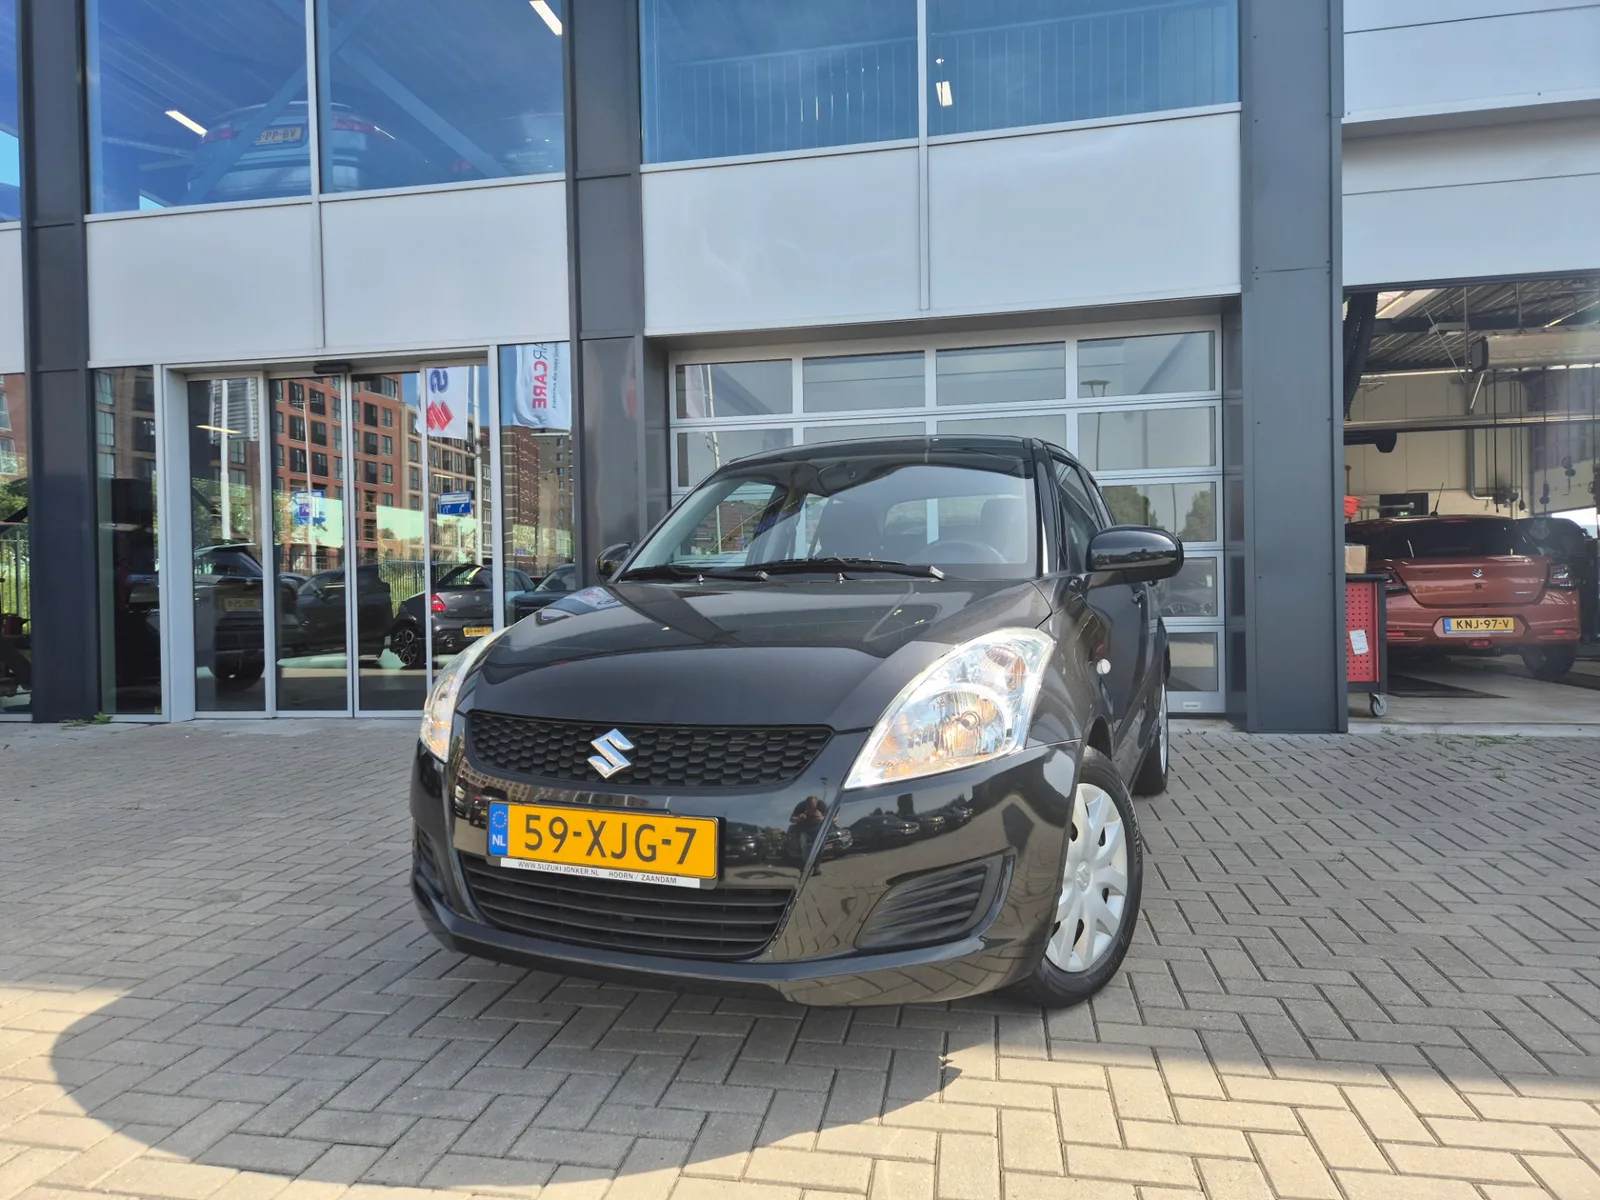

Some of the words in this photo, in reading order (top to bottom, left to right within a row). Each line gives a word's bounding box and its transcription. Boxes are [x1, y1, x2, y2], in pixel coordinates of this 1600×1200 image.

[1456, 619, 1509, 629] KNJ-97-V
[492, 834, 506, 847] NL
[524, 813, 697, 865] 59-XJG-7
[608, 871, 634, 880] HOORN
[641, 874, 677, 884] ZAANDAM
